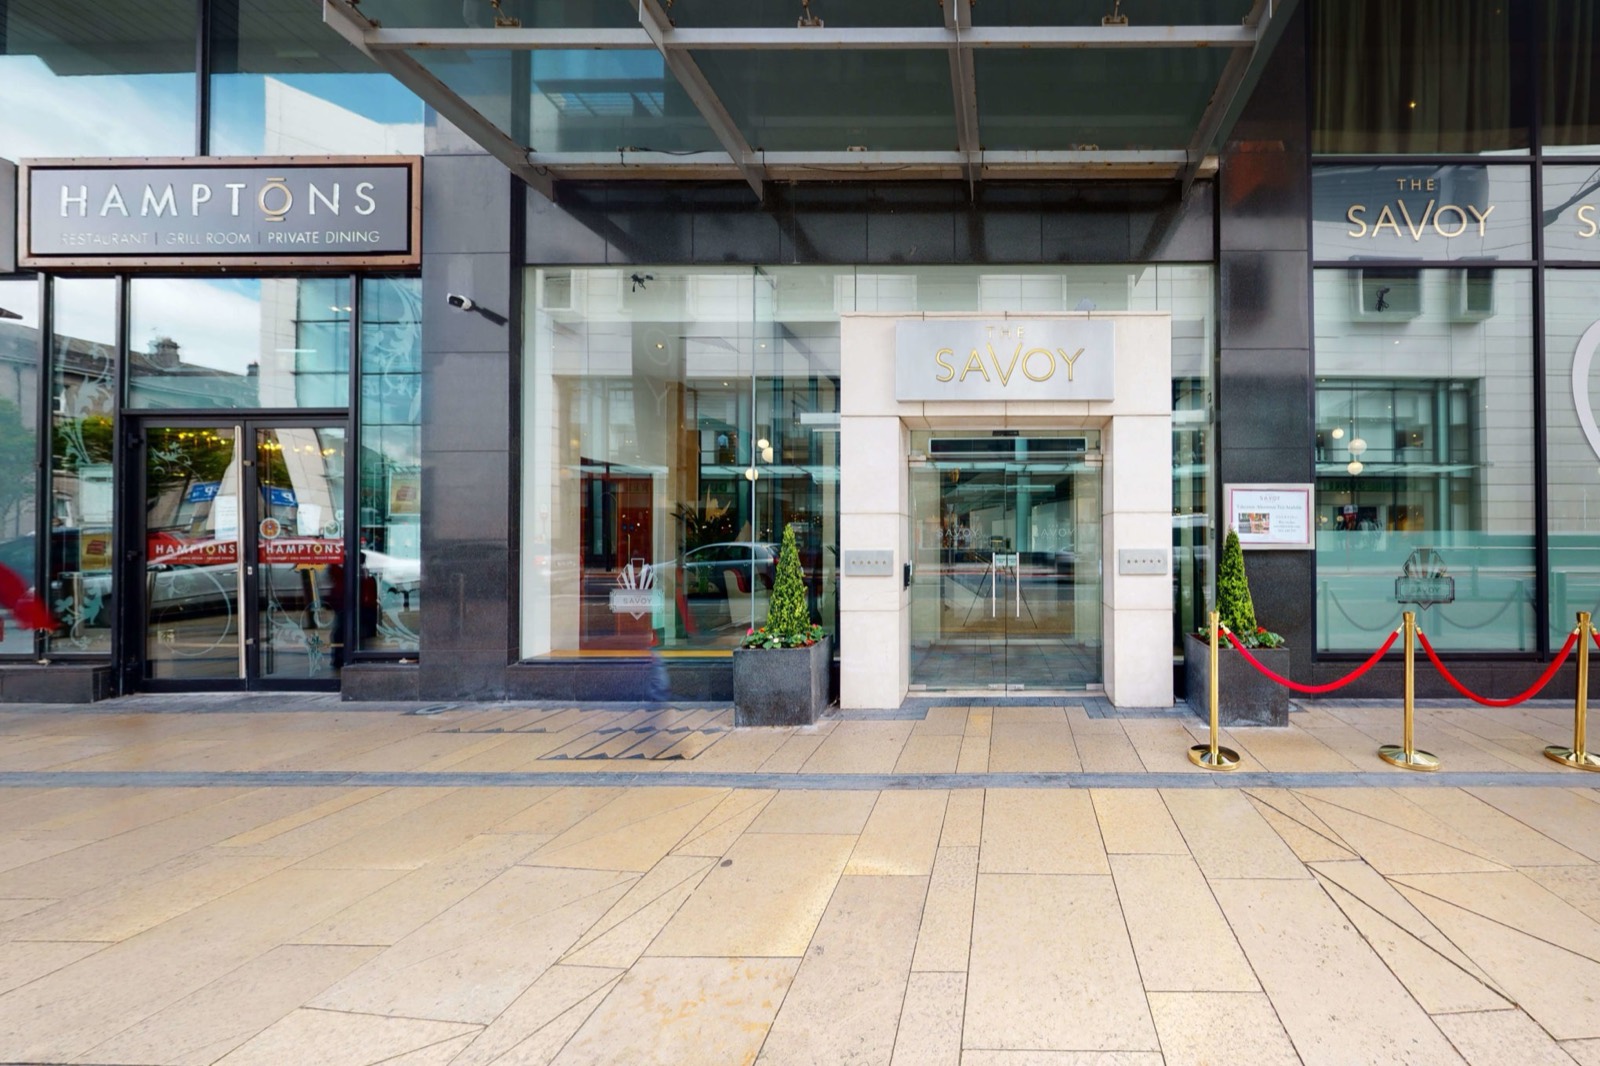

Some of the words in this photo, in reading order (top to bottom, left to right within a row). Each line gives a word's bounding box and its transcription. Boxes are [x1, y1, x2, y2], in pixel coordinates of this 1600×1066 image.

[1397, 178, 1435, 191] THE
[1347, 199, 1496, 241] SAVOY
[61, 232, 149, 245] RESTAURANT
[166, 232, 201, 245] GRILL
[206, 231, 250, 245] ROOM
[268, 231, 320, 244] PRIVATE
[325, 230, 380, 243] DINING
[986, 326, 1025, 339] THE
[935, 342, 1085, 387] SAVOY
[936, 528, 979, 538] SAVOY
[622, 597, 653, 605] SAVOY
